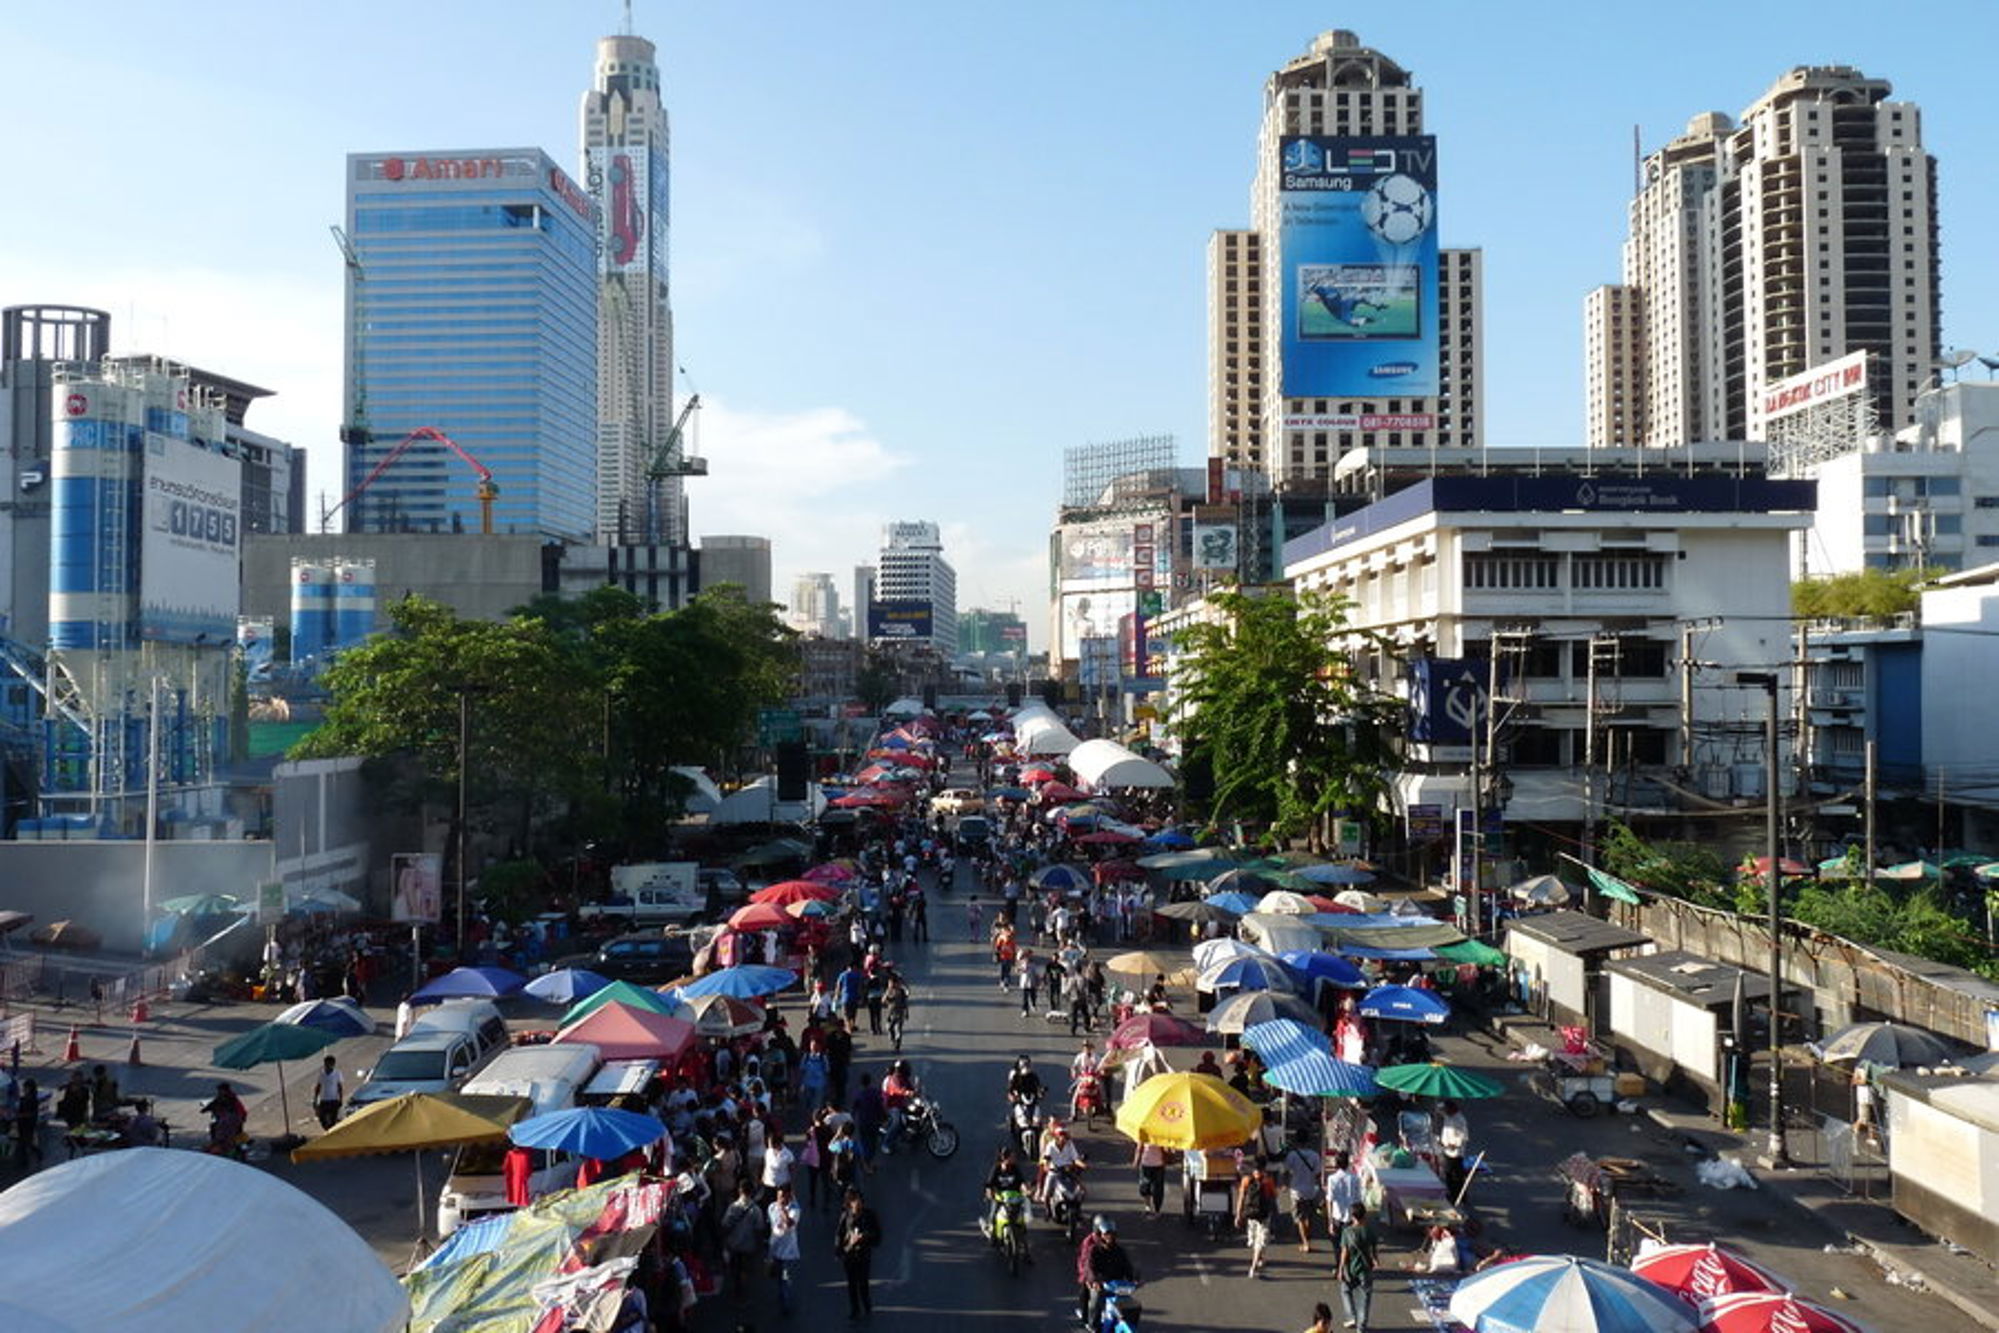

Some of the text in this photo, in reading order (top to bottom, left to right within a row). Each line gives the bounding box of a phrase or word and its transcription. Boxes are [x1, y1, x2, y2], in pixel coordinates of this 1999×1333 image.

[413, 156, 504, 179] Amari
[1399, 150, 1433, 173] TV
[1285, 175, 1352, 191] Samsung
[1373, 365, 1413, 375] SAMSUNG
[1814, 371, 1840, 397] CITY
[1649, 495, 1678, 505] Bank
[173, 503, 235, 542] 1755
[1361, 1008, 1380, 1017] VISA
